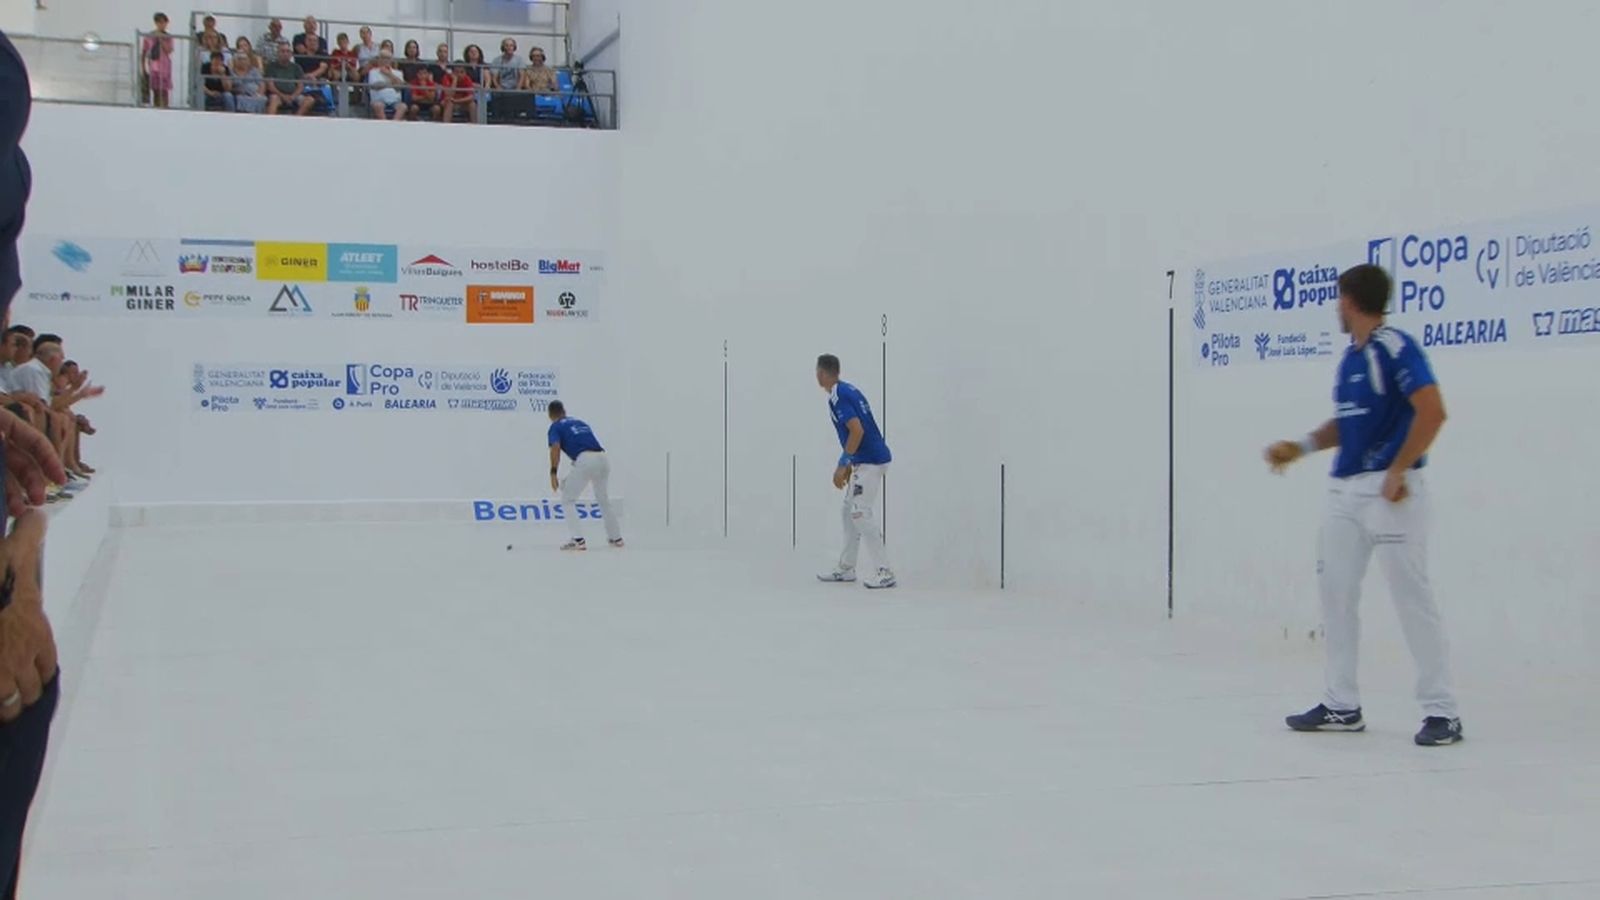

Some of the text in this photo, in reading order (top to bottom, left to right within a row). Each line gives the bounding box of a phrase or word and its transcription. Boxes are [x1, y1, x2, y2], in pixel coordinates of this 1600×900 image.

[1515, 226, 1592, 259] Diputació
[340, 252, 384, 263] ATLEET
[1401, 234, 1469, 273] Copa
[471, 259, 530, 271] hostelBe
[538, 259, 581, 271] BigMat
[1299, 264, 1338, 286] caixa
[1515, 269, 1535, 288] de
[126, 285, 175, 297] MILAR
[1166, 270, 1175, 300] 7
[1208, 274, 1270, 296] GENERALITAT
[126, 298, 175, 310] GINER
[1210, 295, 1268, 313] VALENCIANA
[1298, 285, 1338, 308] popu
[1401, 280, 1446, 313] Pro
[881, 313, 887, 336] 8
[1423, 318, 1507, 347] BALEARIA
[1211, 333, 1241, 349] Pilota
[1211, 350, 1230, 366] Pro
[208, 370, 265, 379] GENERALITAT
[291, 371, 324, 379] caixa
[370, 364, 414, 380] Copa
[441, 370, 480, 381] Diputació
[209, 380, 265, 388] VALENCIANA
[292, 379, 341, 389] popular
[370, 382, 399, 395] Pro
[211, 396, 239, 404] Pilota
[211, 404, 229, 412] Pro
[385, 400, 436, 409] BALEARIA
[473, 499, 603, 521] Benissa
